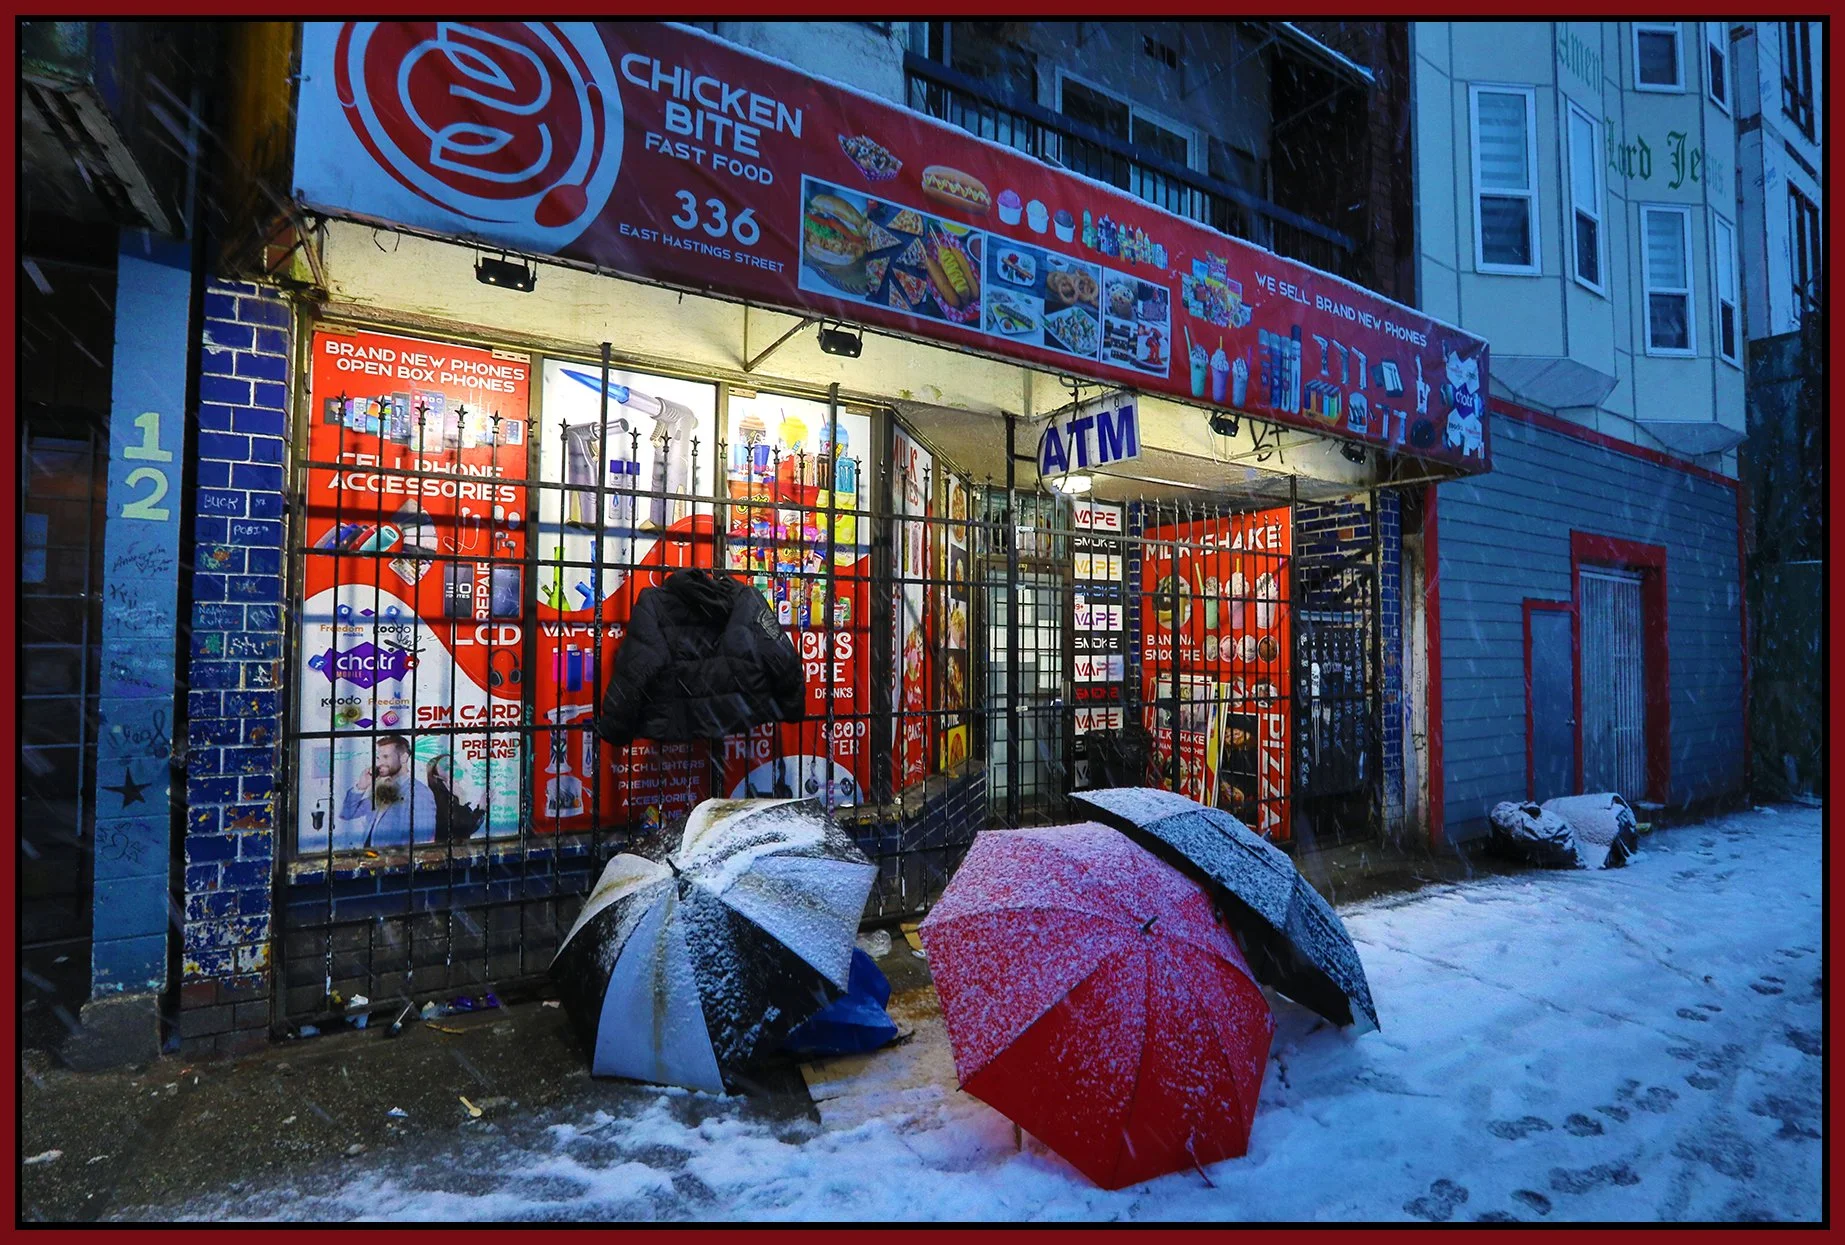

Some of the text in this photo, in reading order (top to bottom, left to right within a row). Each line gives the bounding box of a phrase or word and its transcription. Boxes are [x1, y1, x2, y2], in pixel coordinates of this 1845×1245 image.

[620, 53, 803, 139] CHICKEN
[665, 100, 761, 159] BITE
[645, 131, 774, 185] FAST FOOD
[1606, 116, 1651, 181] Lord
[671, 189, 761, 246] 336
[619, 223, 784, 273] EAST HASTINGS STREET
[1255, 271, 1428, 348] WE SELL BRAND NEW PHONES
[325, 340, 525, 381] BRAND NEW PHONES
[336, 357, 516, 393] OPEN BOX PHONES
[1042, 405, 1137, 476] ATM
[328, 472, 516, 502] ACCESSORIES
[1074, 510, 1117, 527] VAPE
[1074, 560, 1118, 575] VAPE
[450, 623, 522, 646] LCD
[1075, 612, 1118, 627] VAPE
[1074, 637, 1118, 649] SMOKE
[1075, 662, 1118, 677] VAPE
[417, 703, 521, 721] SIM CARD
[1075, 712, 1119, 729] VAPE
[461, 738, 521, 750] PREPAID
[467, 749, 517, 760] PLANS
[622, 746, 658, 756] METAL
[1261, 712, 1285, 831] PIZZA
